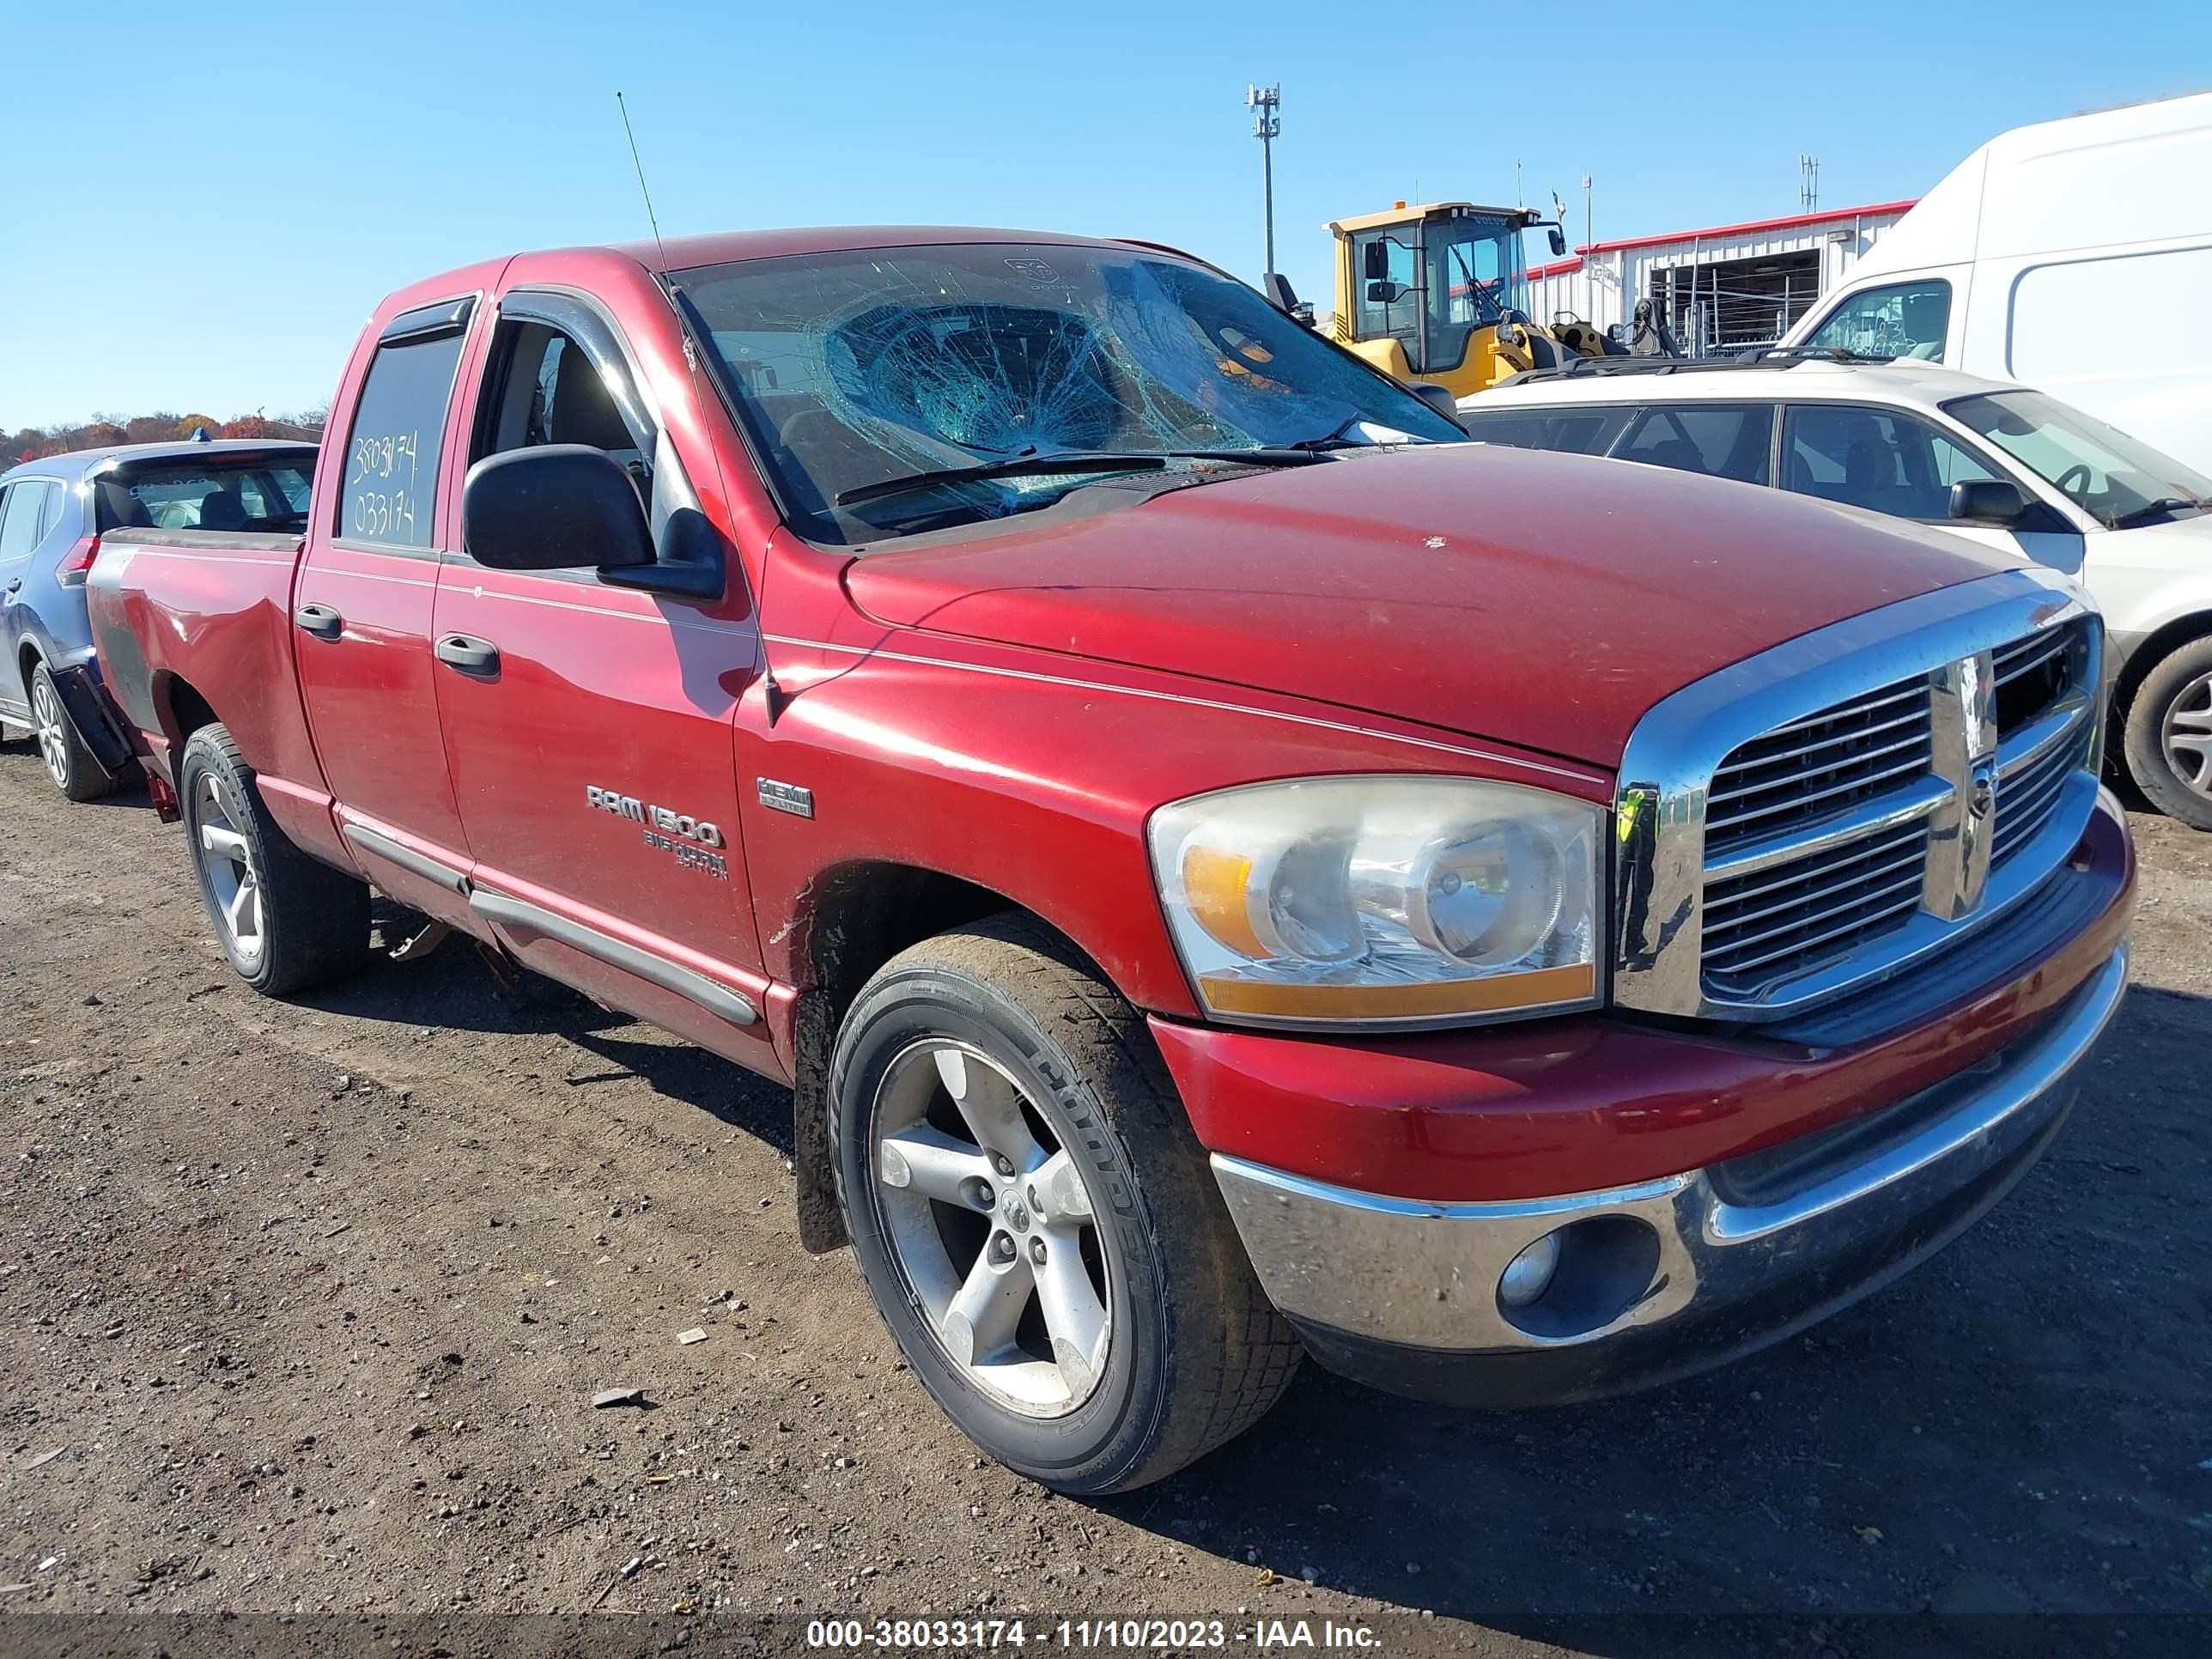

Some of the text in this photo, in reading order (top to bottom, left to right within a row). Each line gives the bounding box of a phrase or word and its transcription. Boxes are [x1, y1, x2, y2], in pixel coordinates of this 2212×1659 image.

[757, 776, 811, 805] HEMI
[586, 784, 722, 848] RAM 1500
[778, 799, 809, 816] LITER
[643, 829, 672, 852] BIG
